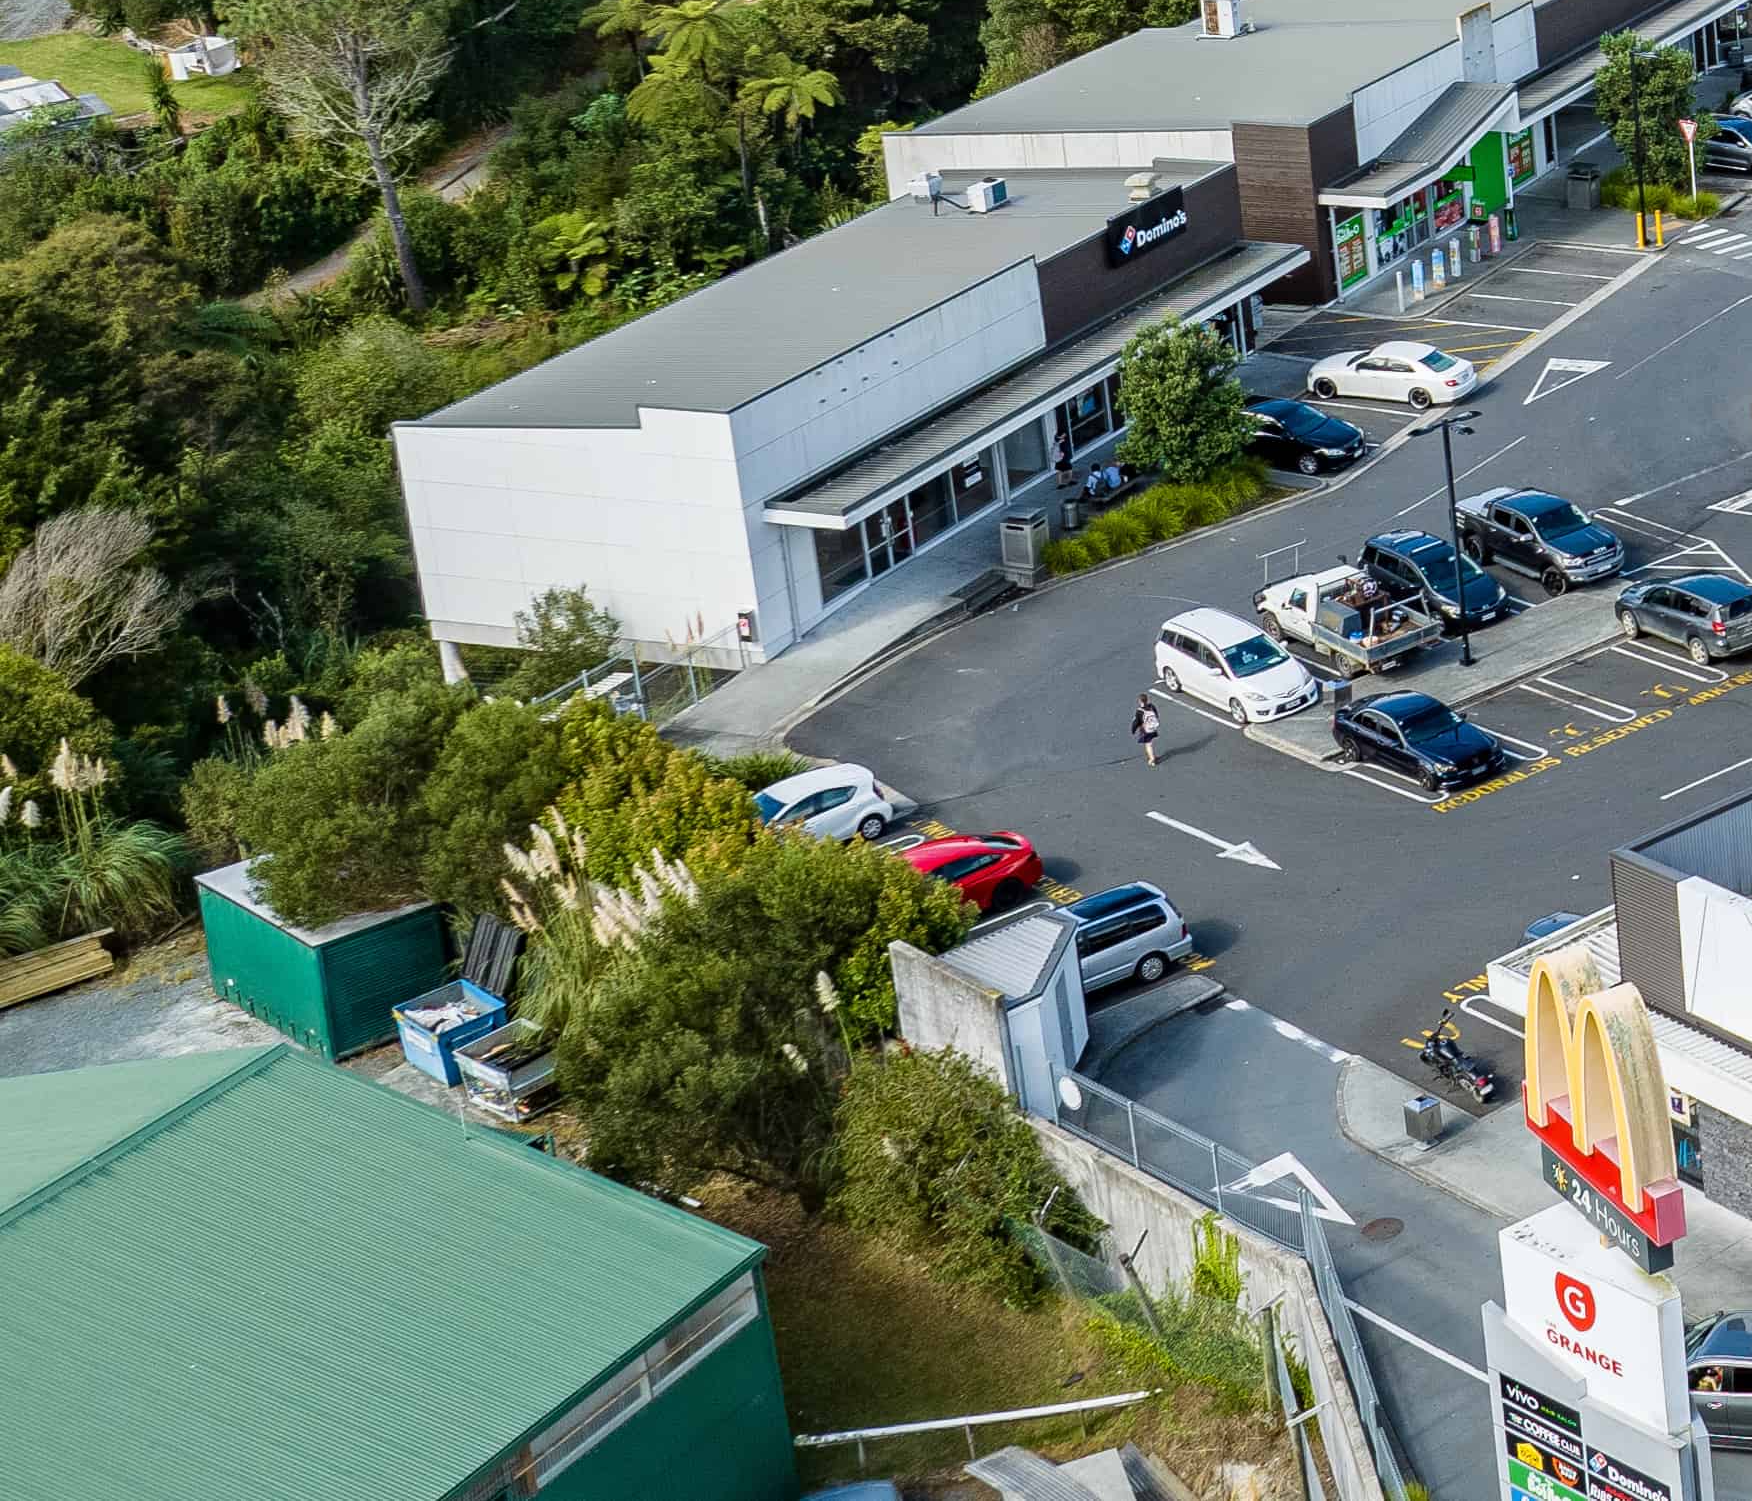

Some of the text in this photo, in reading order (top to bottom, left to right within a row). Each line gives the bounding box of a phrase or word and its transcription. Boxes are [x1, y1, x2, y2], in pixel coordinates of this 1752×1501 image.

[1136, 209, 1187, 248] Domino's
[1572, 1180, 1641, 1259] 24 Hours
[1546, 1328, 1624, 1378] GRANGE
